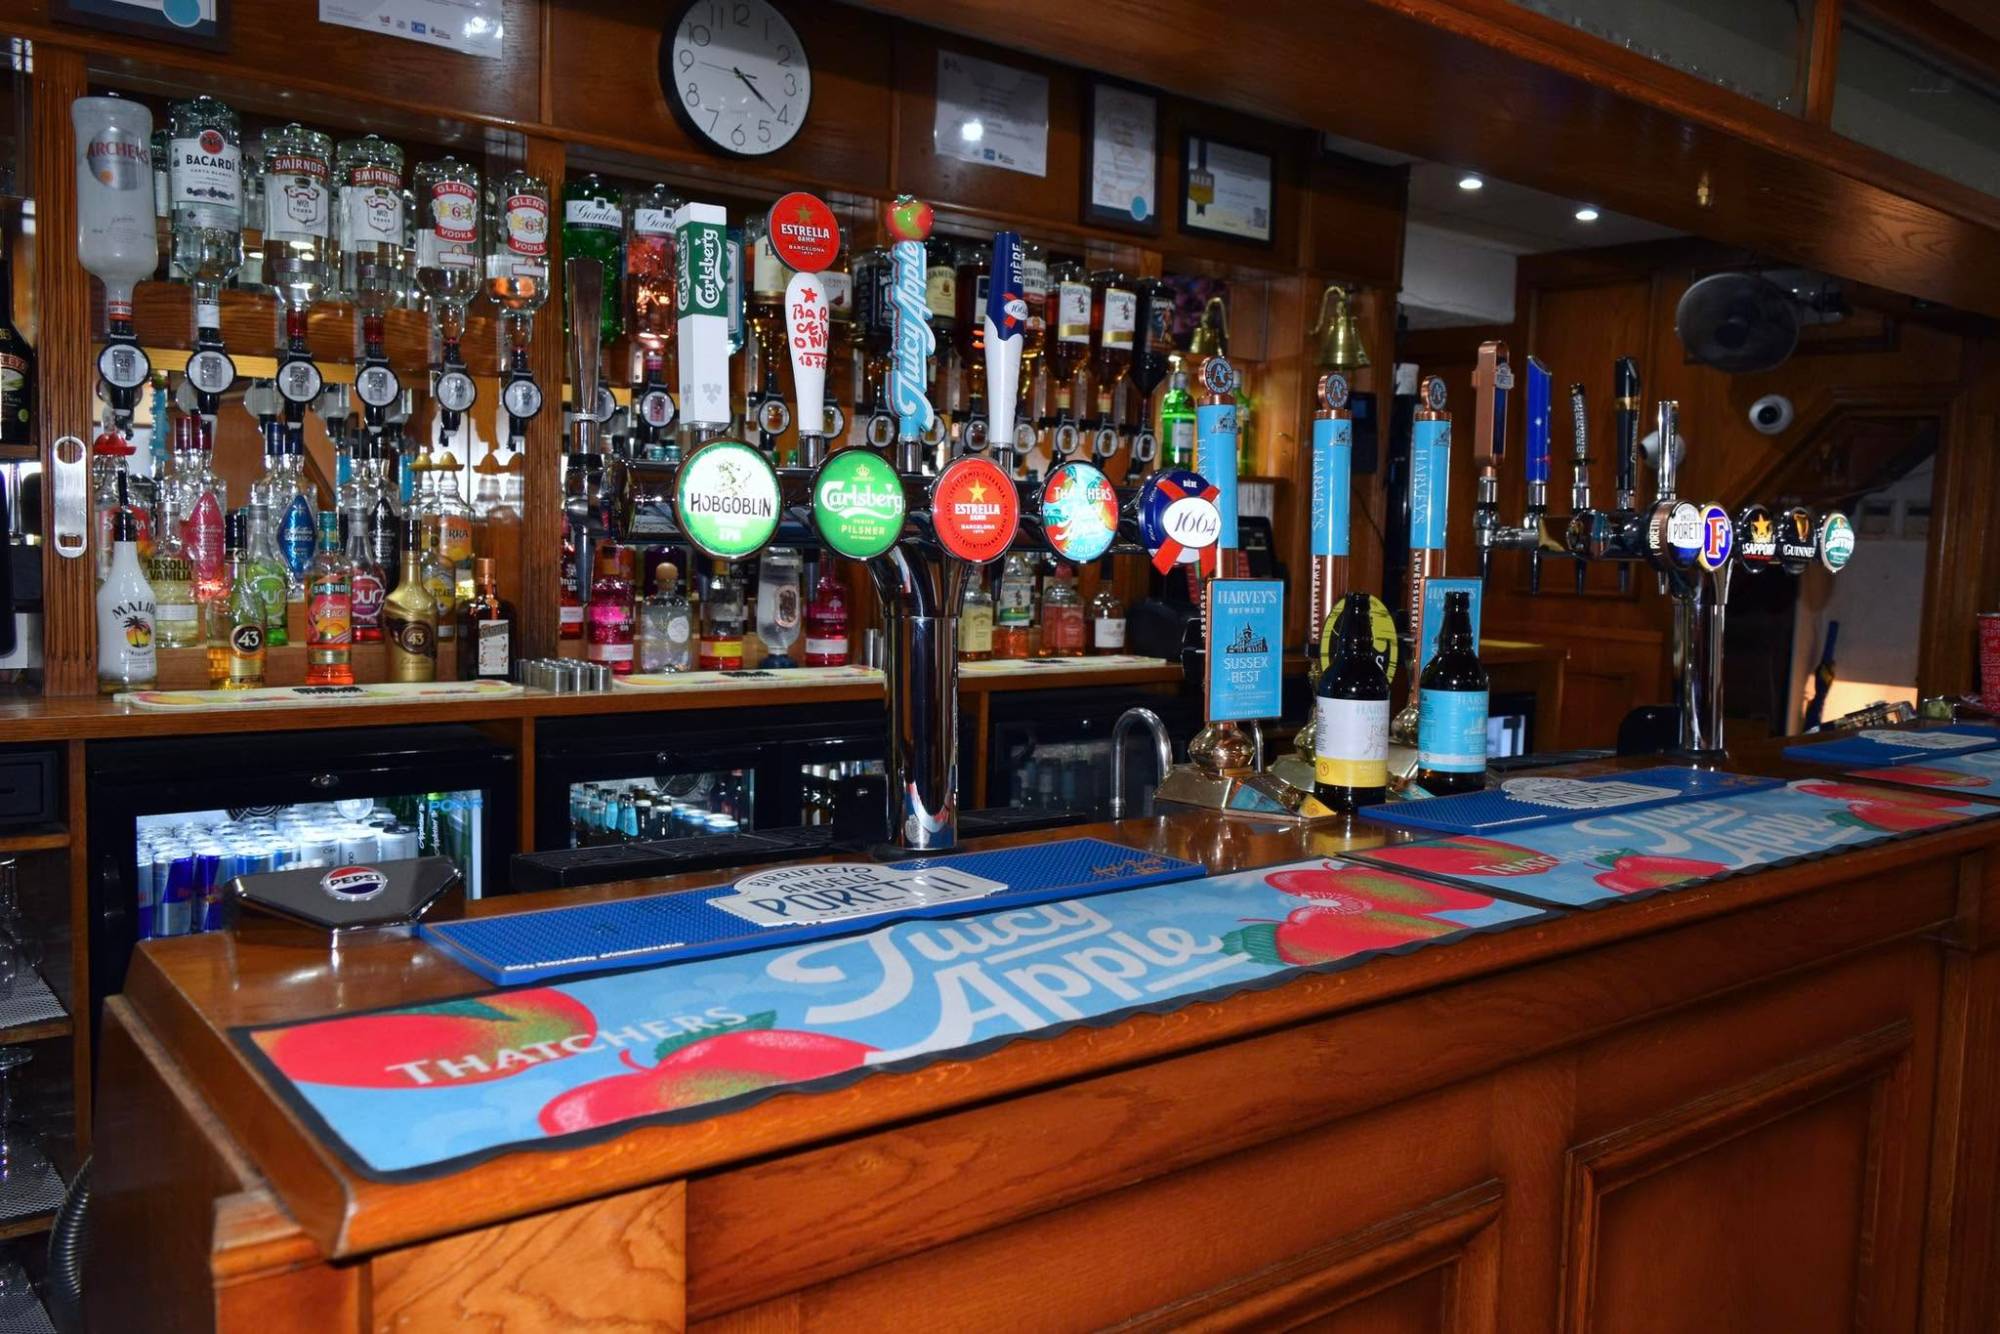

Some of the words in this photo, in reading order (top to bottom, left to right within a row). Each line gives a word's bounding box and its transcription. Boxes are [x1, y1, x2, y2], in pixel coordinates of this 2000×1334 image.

[711, 4, 724, 31] 11
[733, 3, 750, 28] 12
[688, 22, 711, 47] 10
[764, 18, 769, 41] 1
[679, 49, 695, 74] 9
[777, 44, 792, 68] 2
[686, 83, 700, 108] 8
[784, 73, 797, 97] 3
[704, 108, 720, 134] 7
[776, 104, 789, 125] 4
[731, 124, 746, 147] 6
[757, 119, 772, 144] 5
[88, 141, 150, 165] ARCHERS
[275, 158, 327, 175] SMIRNOFF
[441, 230, 473, 239] VODKA
[781, 223, 830, 239] ESTRELLA
[514, 241, 544, 252] VODKA
[695, 228, 725, 309] Carlsberg
[1010, 243, 1023, 284] BIÈRE
[897, 240, 936, 355] Apple
[792, 304, 828, 324] BAR
[1054, 485, 1113, 501] THAHERS
[1413, 449, 1428, 525] HARVEY'S
[690, 493, 772, 517] HOBGOBLIN
[820, 480, 903, 519] Carlsberg
[954, 503, 1001, 515] ESTRELLA
[841, 524, 885, 536] PILSNER
[1174, 512, 1217, 537] 1664
[1707, 517, 1729, 559] F
[1218, 590, 1277, 604] HARVEY'S
[112, 601, 157, 619] MALIB
[237, 631, 260, 647] 43
[408, 632, 425, 646] 43
[1224, 657, 1269, 670] SUSSEX
[1231, 671, 1261, 684] BEST
[330, 873, 380, 886] PEPSI
[749, 866, 873, 888] BIRRIFICIO
[779, 873, 880, 893] ANGELO
[765, 900, 1114, 1026] Juicy
[864, 925, 1225, 1065] Apple
[385, 1006, 748, 1086] THATCHERS
